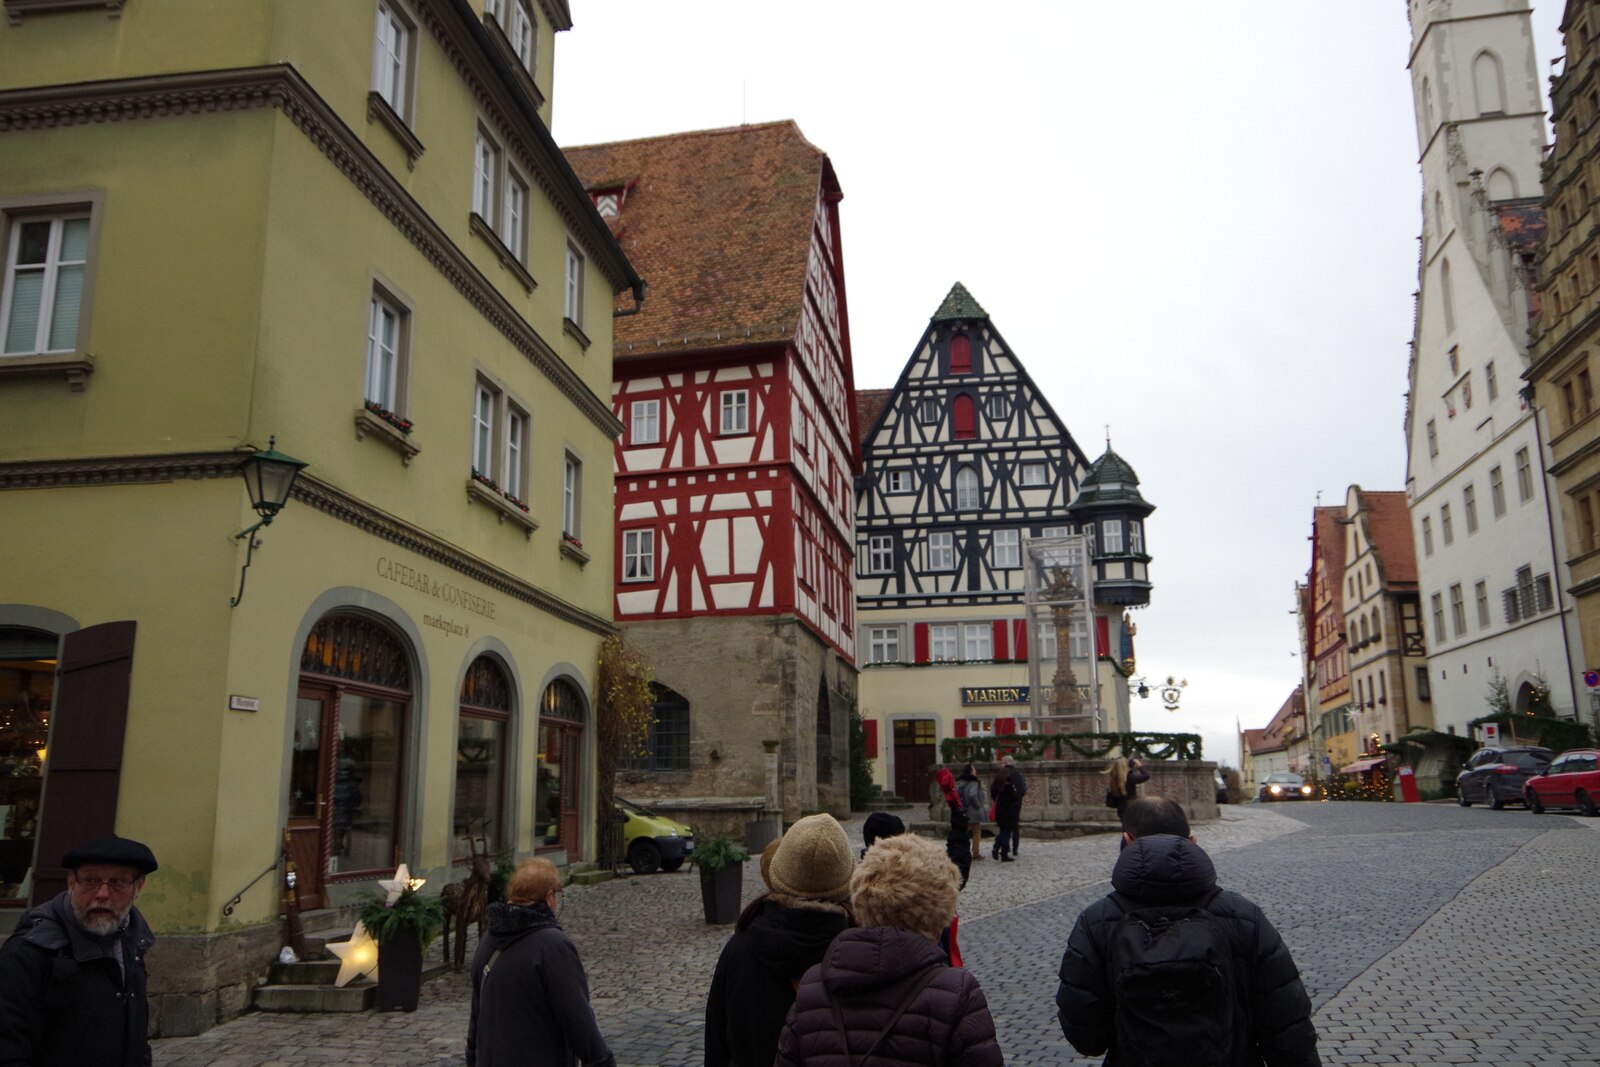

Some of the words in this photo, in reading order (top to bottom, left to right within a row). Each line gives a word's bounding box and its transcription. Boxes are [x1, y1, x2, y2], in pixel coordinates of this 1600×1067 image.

[376, 557, 430, 594] CAFEBAR
[431, 582, 440, 598] &
[442, 583, 496, 620] CONFISERIE
